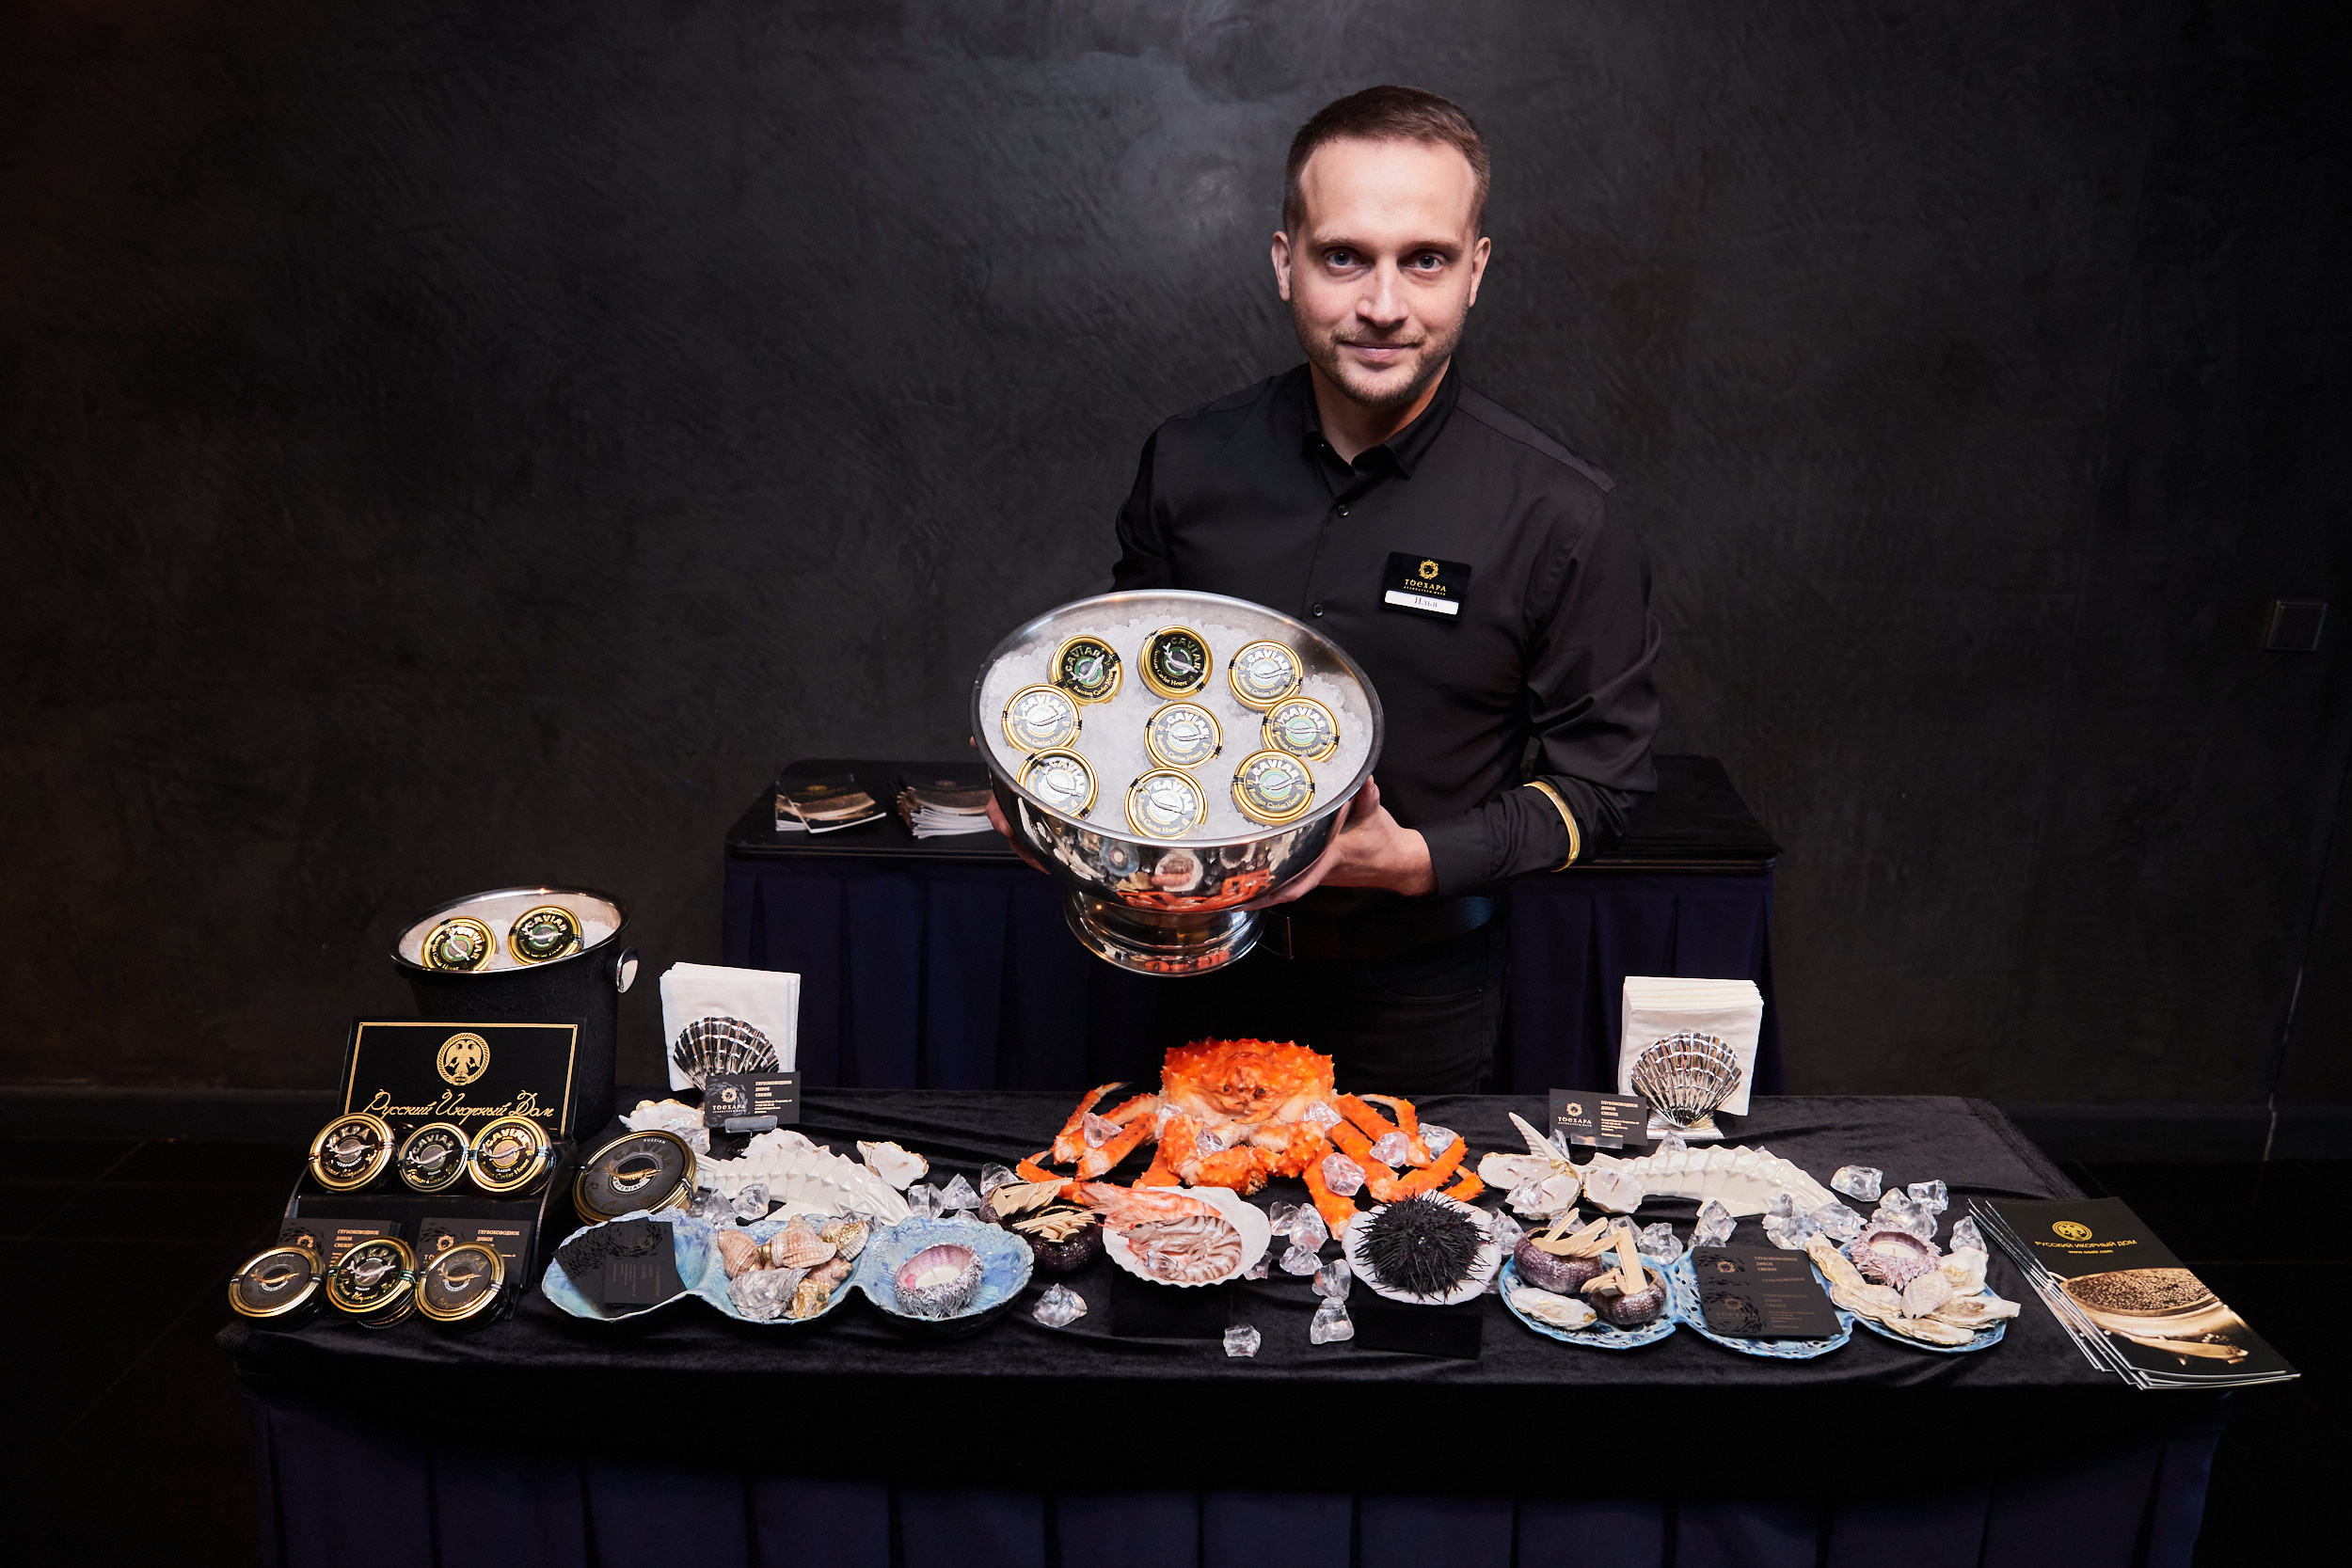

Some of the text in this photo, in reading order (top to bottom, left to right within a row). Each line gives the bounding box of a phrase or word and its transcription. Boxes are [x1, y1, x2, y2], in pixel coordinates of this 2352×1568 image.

[1065, 647, 1101, 672] CAVIAR
[1171, 637, 1202, 671] CAVIAR
[1247, 650, 1290, 671] CAVIAR
[1020, 695, 1067, 717] CAVIAR
[1167, 712, 1210, 736] CAVIAR
[1281, 706, 1327, 729] CAVIAR
[1048, 758, 1086, 794] CAVIAR
[1252, 760, 1300, 779] CAVIAR
[1152, 779, 1194, 812] CAVIAR
[527, 914, 568, 932] CAVIAR
[362, 1088, 555, 1126] Русский Икорный Дом
[412, 1134, 454, 1154] CAVIAR
[485, 1129, 532, 1147] CAVIAR
[2117, 1239, 2137, 1247] ДОМ
[354, 1247, 397, 1267] ИКРА
